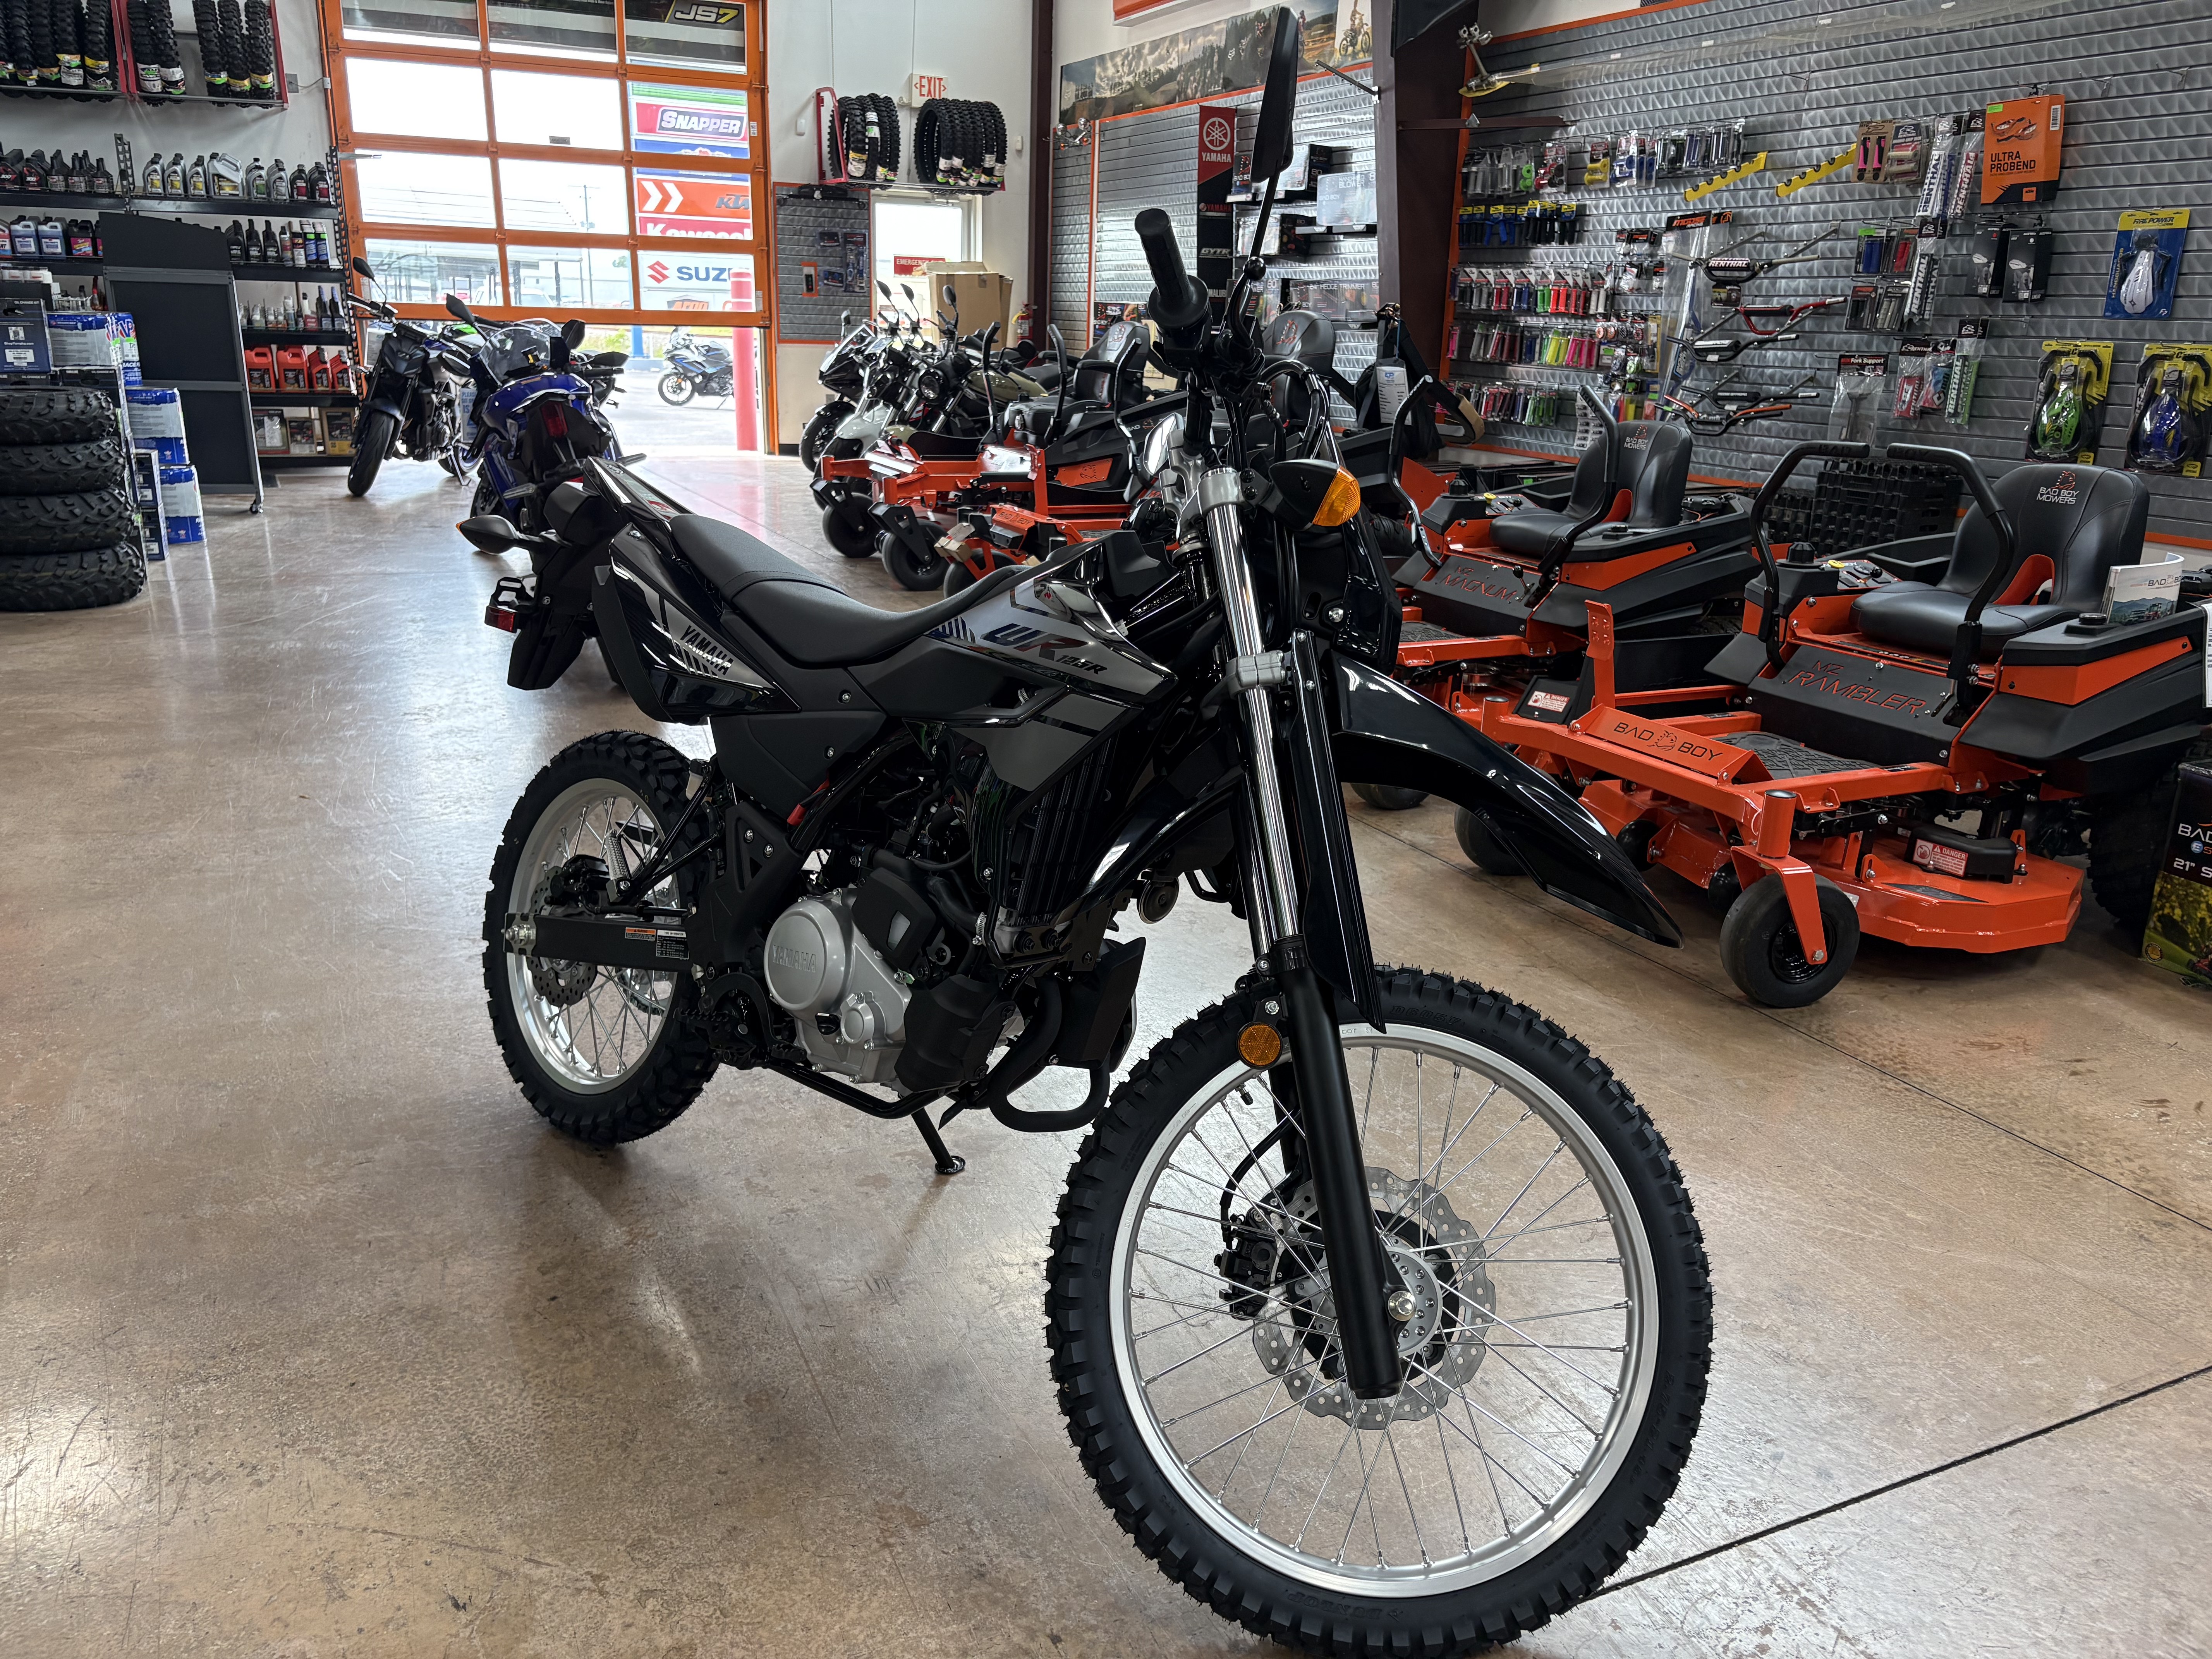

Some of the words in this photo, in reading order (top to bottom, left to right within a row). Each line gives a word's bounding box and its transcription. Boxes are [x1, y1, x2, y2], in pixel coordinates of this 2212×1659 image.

[675, 5, 739, 24] JS7
[919, 76, 943, 99] EXIT
[661, 111, 741, 134] SNAPPER
[1202, 152, 1232, 163] YAMAHA
[1991, 151, 2021, 162] ULTRA
[1990, 160, 2036, 173] PROBEND
[1955, 152, 1976, 215] RENTHAL
[1673, 216, 1705, 227] MOOSE
[1201, 247, 1231, 256] GYTR
[677, 266, 731, 282] SUZ
[1267, 280, 1277, 289] 80
[1911, 255, 1929, 314] RENTHAL
[1208, 289, 1226, 298] MALUB
[1948, 358, 1963, 414] RENTHAL
[2036, 493, 2077, 505] MOWERS
[2039, 487, 2059, 496] BAD
[2060, 489, 2080, 497] BOY
[1454, 565, 1474, 578] MZ
[1442, 574, 1518, 601] MAGNUM
[2148, 579, 2167, 587] BAD
[680, 625, 734, 676] YAMAHA
[1054, 654, 1108, 675] 125R
[1812, 660, 1845, 676] MZ
[1551, 694, 1569, 702] DANGER
[1788, 671, 1927, 714] RAMBLER
[1613, 721, 1655, 743] BAD
[1677, 742, 1723, 762] BOY
[1942, 847, 1966, 860] DANGER
[2173, 857, 2195, 871] 21"
[773, 945, 817, 973] YAMAHA
[1389, 1005, 1462, 1025] D605F
[1288, 1592, 1381, 1621] DUNLOP
